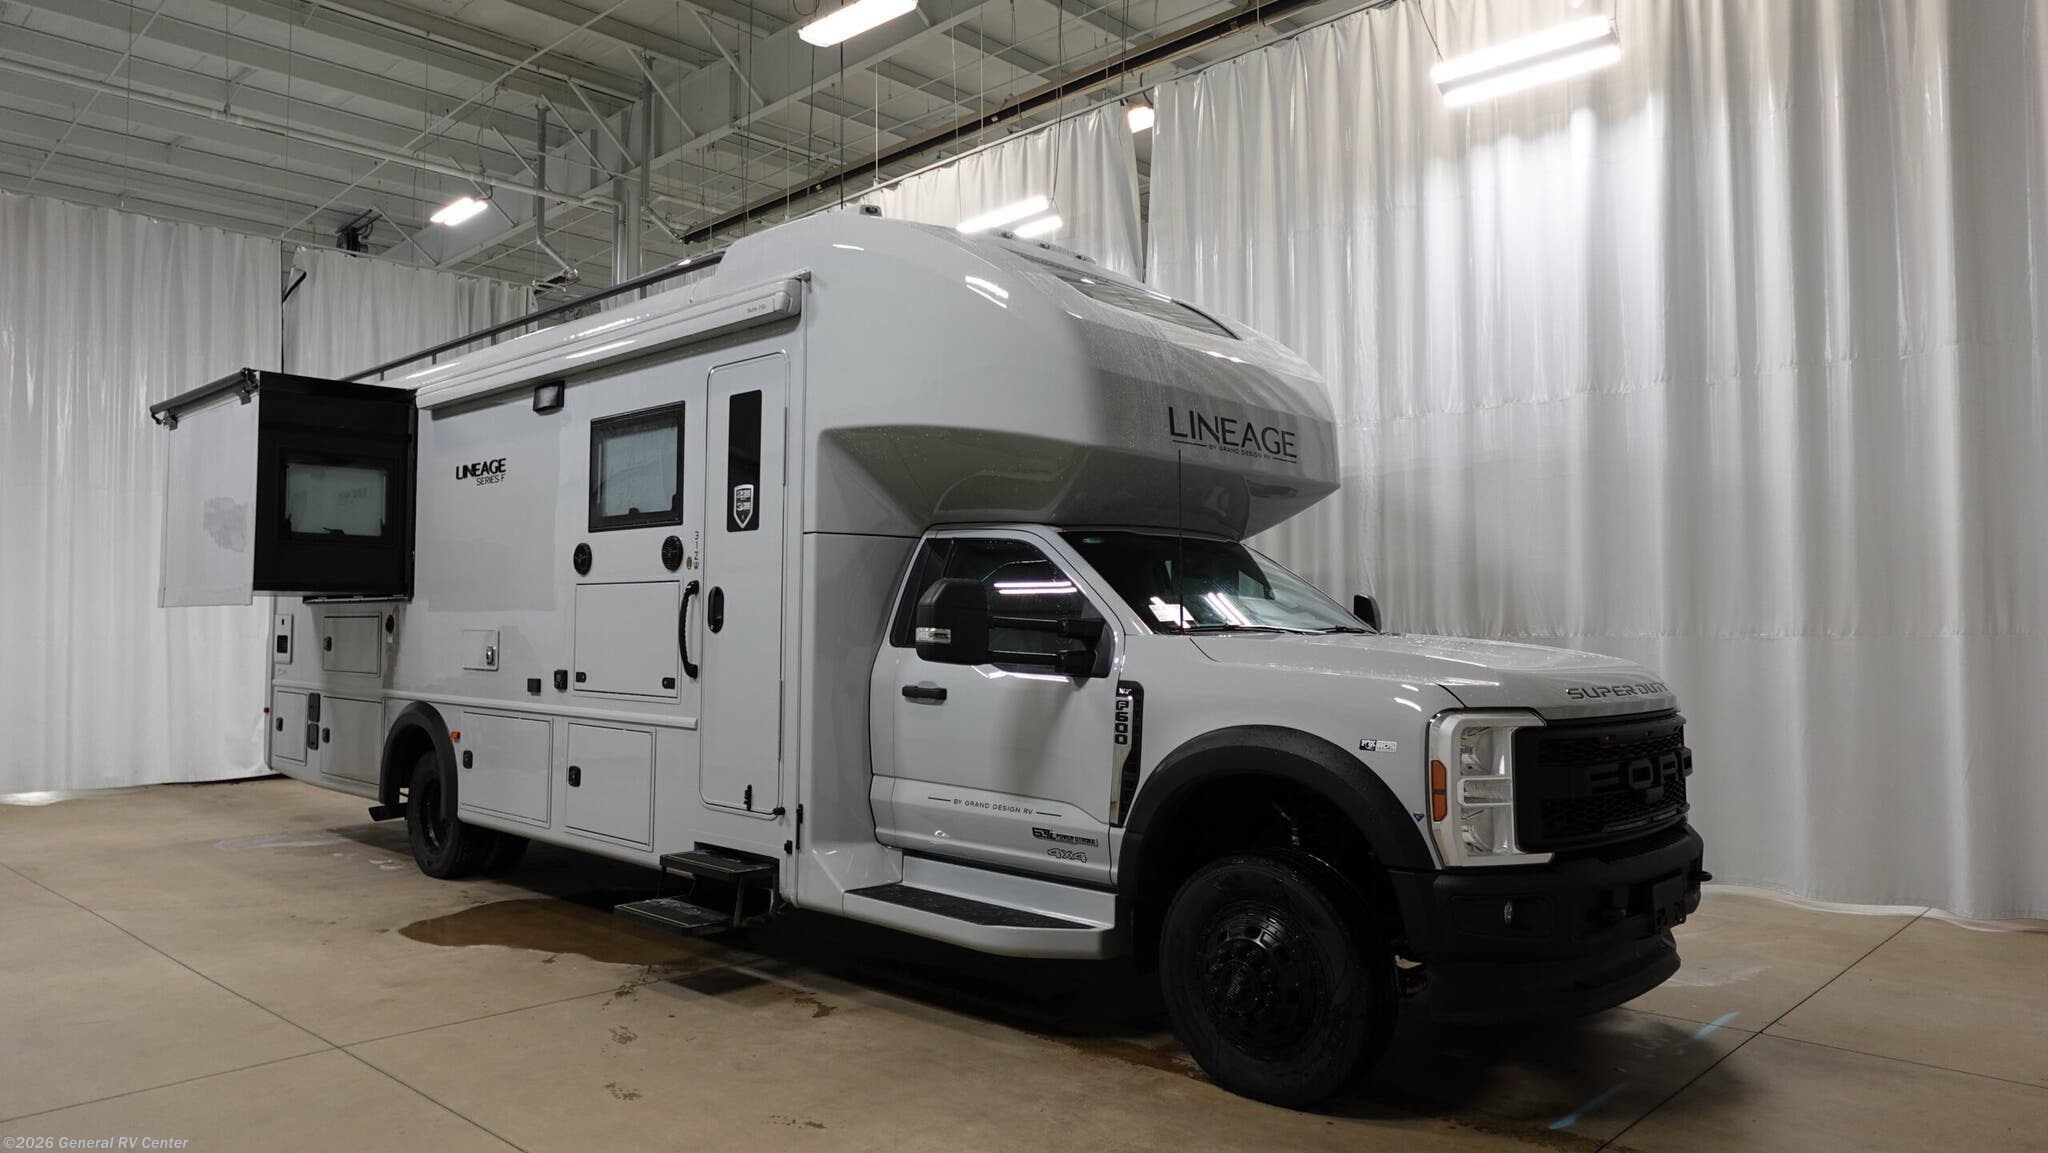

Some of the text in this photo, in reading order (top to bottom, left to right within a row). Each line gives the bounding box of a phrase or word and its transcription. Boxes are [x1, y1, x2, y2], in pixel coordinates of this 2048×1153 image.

[1168, 406, 1297, 458] LINEAGE
[456, 458, 506, 480] LINEAGE
[476, 473, 506, 486] SERIES F
[1566, 685, 1639, 699] SUPER
[964, 800, 990, 809] GRAND
[992, 803, 1021, 813] DESIGN
[1023, 807, 1034, 815] RV
